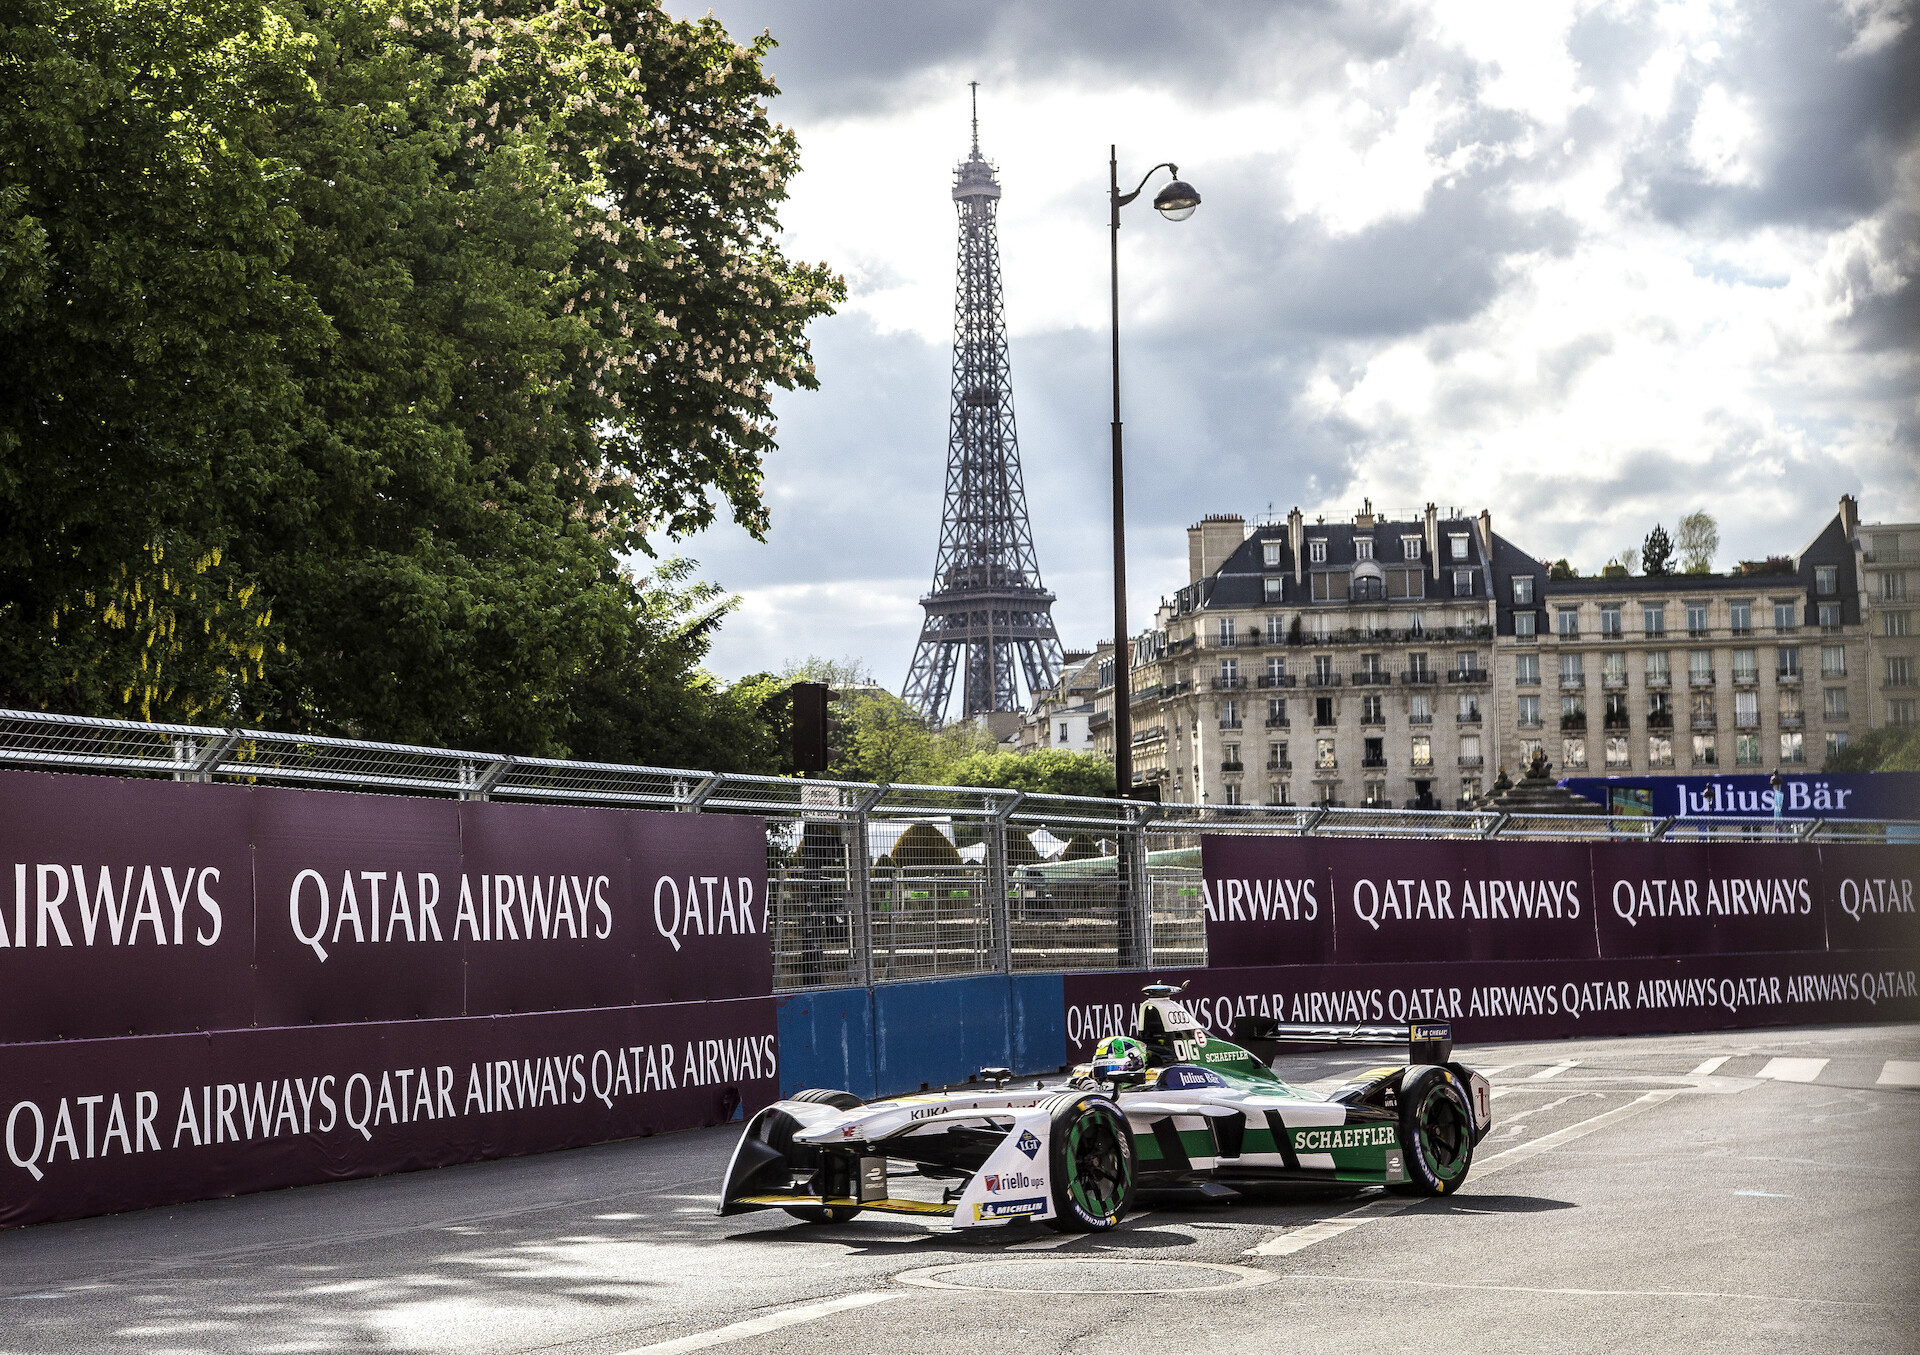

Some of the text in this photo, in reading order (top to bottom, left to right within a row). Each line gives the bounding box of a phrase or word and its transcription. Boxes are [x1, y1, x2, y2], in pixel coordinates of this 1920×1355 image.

[1677, 781, 1852, 816] Julius Bär
[289, 868, 612, 963] QATAR AIRWAYS
[653, 875, 757, 952] QATAR
[1353, 878, 1581, 931] QATAR AIRWAYS
[1612, 878, 1812, 927] QATAR AIRWAYS
[1839, 878, 1916, 922] QATAR
[1215, 994, 1285, 1037] QATAR
[1292, 988, 1384, 1023] AIRWAYS
[1388, 987, 1464, 1024] QATAR
[1469, 985, 1559, 1018] AIRWAYS
[1561, 981, 1632, 1020] QATAR
[1637, 977, 1718, 1009] AIRWAYS
[1719, 976, 1783, 1013] QATAR
[1787, 973, 1859, 1003] AIRWAYS
[1861, 970, 1918, 1005] QATAR
[1067, 1005, 1124, 1049] QATAR
[1173, 1040, 1200, 1061] DIG
[1205, 1050, 1249, 1063] SCHAEFFLER
[1179, 1072, 1206, 1086] Julius
[5, 1034, 777, 1182] QATAR AIRWAYS QATAR AIRWAYS QATAR AIRWAYS
[1019, 1140, 1039, 1151] LGT
[1294, 1126, 1396, 1150] SCHAEFFLER
[1001, 1172, 1045, 1190] riello ups
[996, 1202, 1043, 1215] MICHELIN
